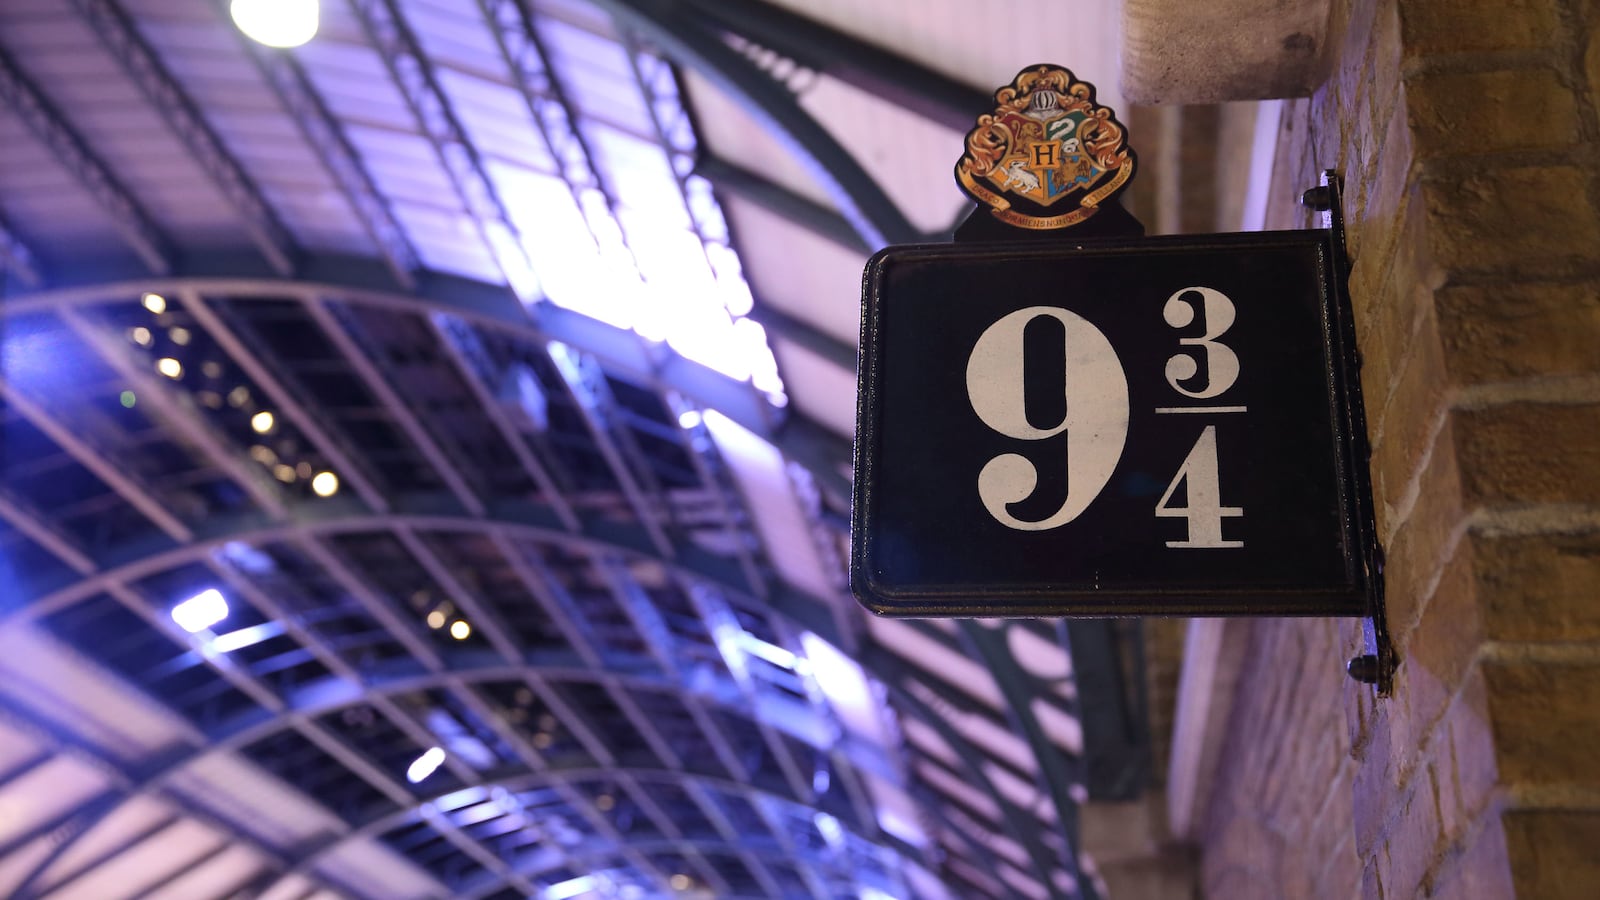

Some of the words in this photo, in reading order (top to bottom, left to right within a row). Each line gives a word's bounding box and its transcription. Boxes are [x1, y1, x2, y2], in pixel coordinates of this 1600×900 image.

[1033, 144, 1056, 166] H
[1163, 286, 1240, 398] 3
[966, 306, 1130, 531] 9
[1155, 425, 1244, 548] 4
